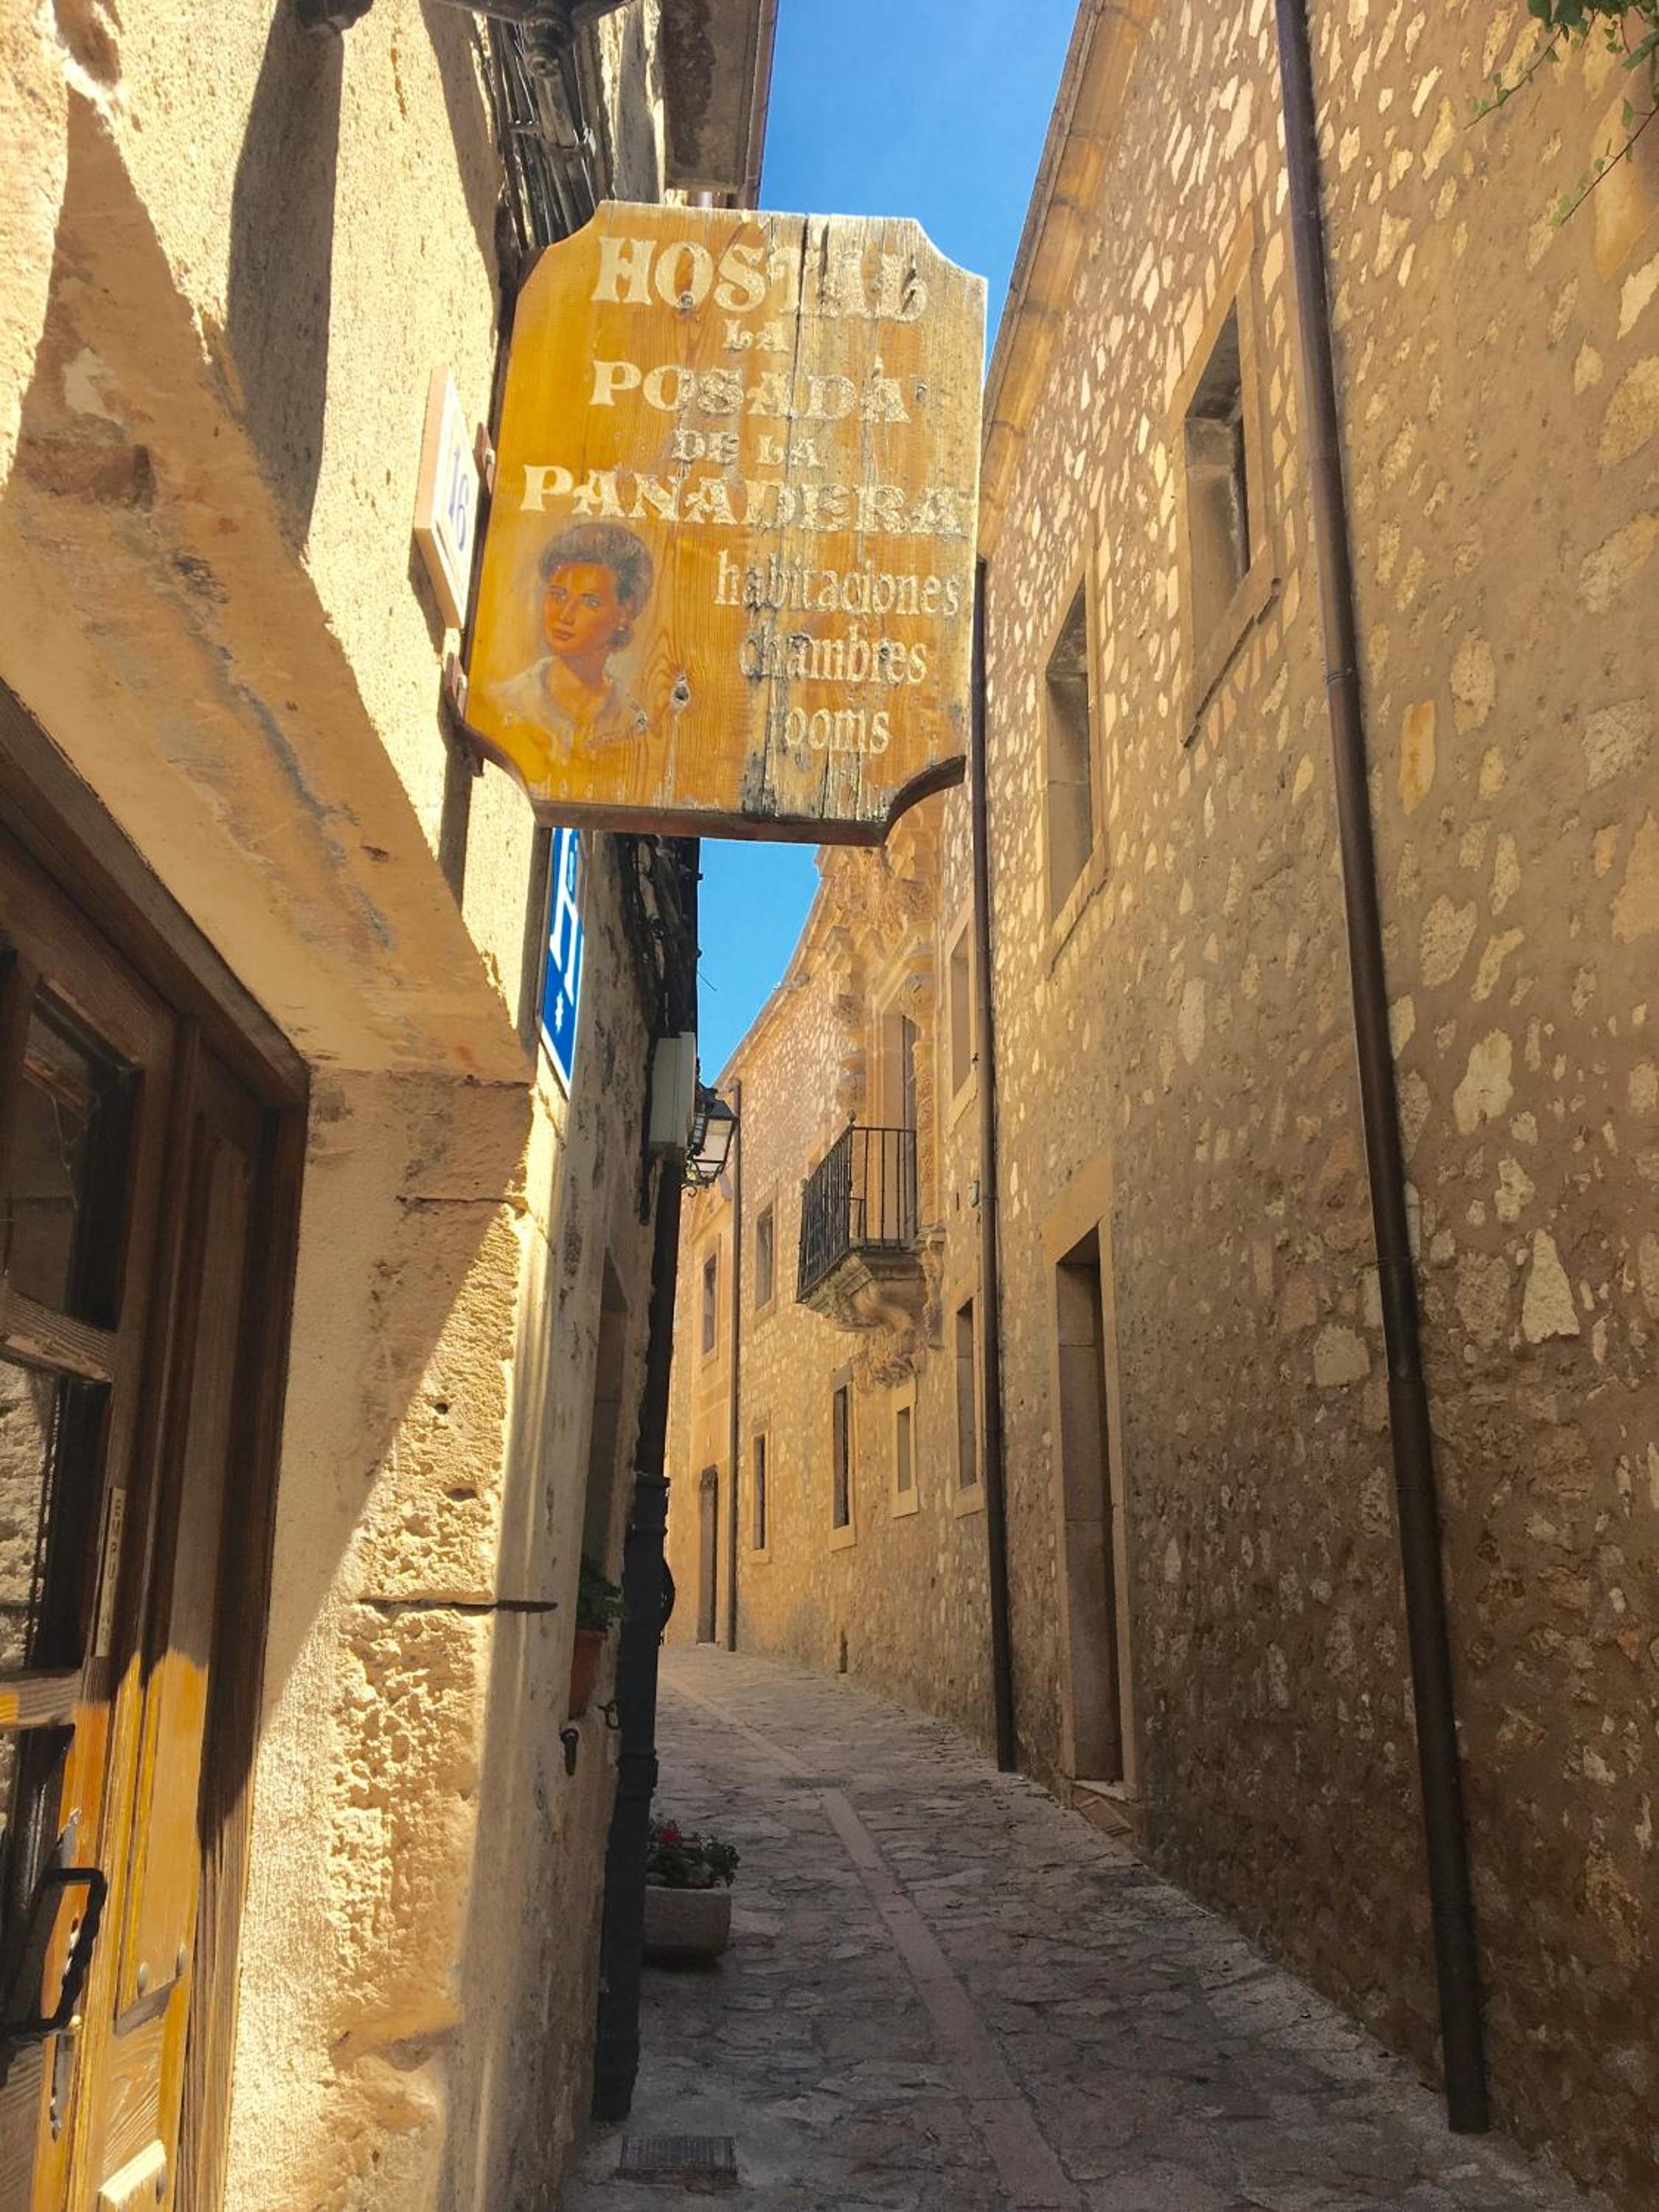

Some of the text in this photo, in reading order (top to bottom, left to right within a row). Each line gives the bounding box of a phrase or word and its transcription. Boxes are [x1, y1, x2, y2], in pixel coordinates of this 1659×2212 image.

[590, 236, 929, 322] HOSTAL
[722, 319, 790, 353] LA
[589, 359, 911, 425] POSADA
[672, 428, 825, 469] DE LA
[448, 446, 470, 552] 16
[518, 464, 967, 538] PANADERA
[714, 549, 959, 616] habitaciones
[739, 624, 928, 684] chambres
[770, 706, 890, 756] ooms
[100, 1497, 122, 1647] EMPUAR
